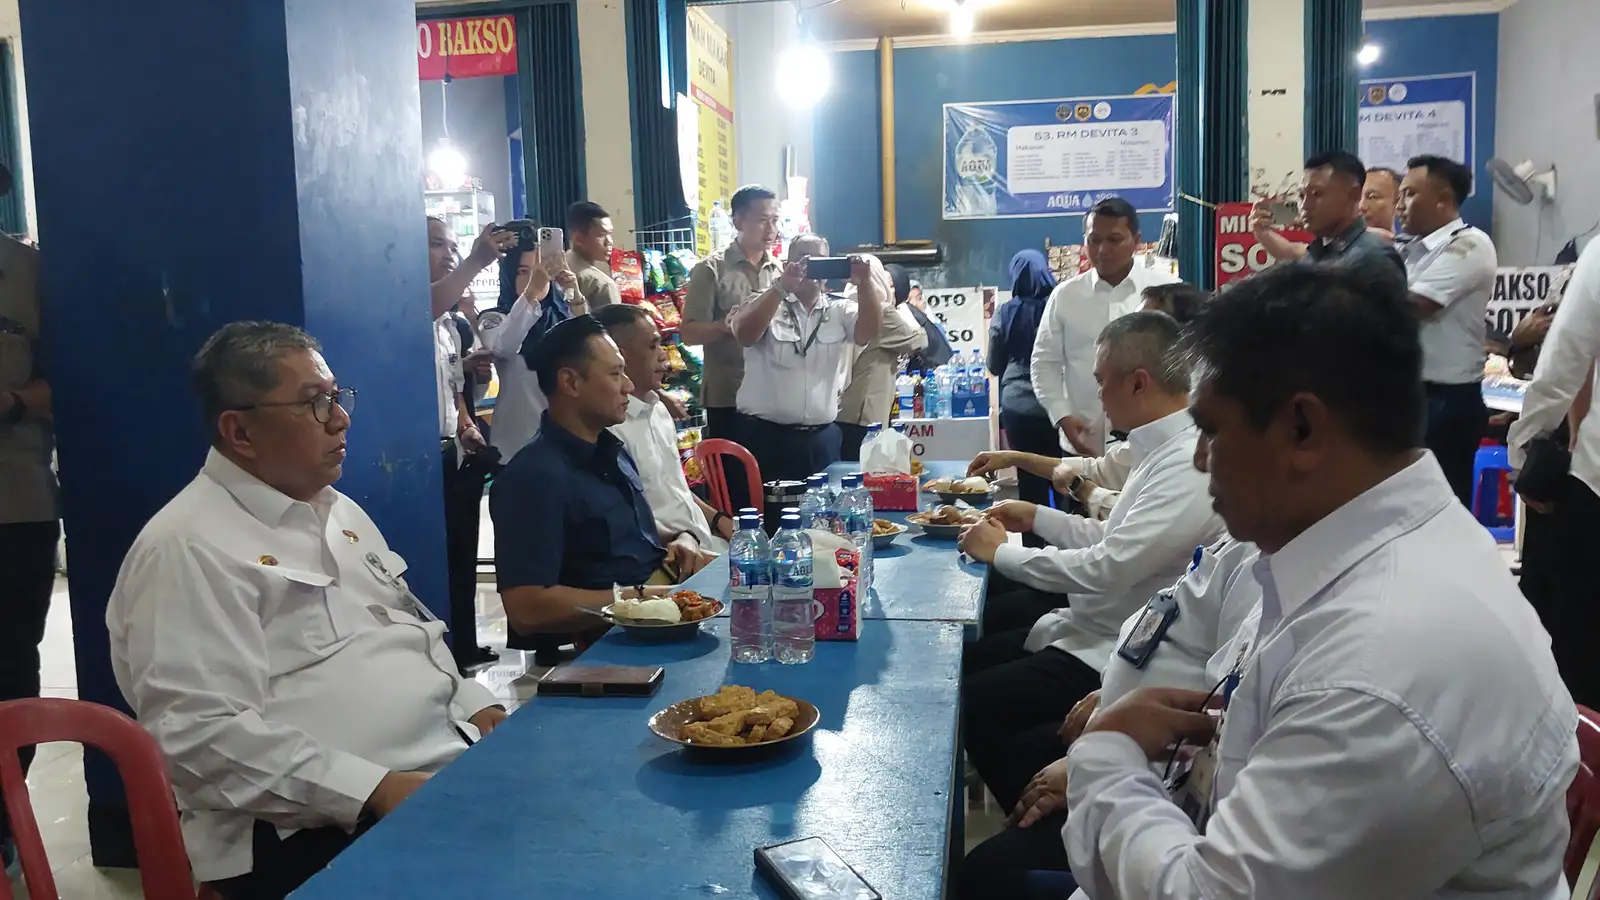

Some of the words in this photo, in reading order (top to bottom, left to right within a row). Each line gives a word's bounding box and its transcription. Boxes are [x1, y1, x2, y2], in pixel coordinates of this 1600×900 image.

[437, 17, 514, 56] BAKSO
[1375, 110, 1424, 122] DEVITA
[1427, 109, 1437, 118] 4
[1057, 129, 1077, 140] RM
[1080, 128, 1127, 139] DEVITA
[1130, 127, 1139, 137] 3
[1047, 194, 1080, 208] AQUA
[1490, 272, 1550, 301] AKSO
